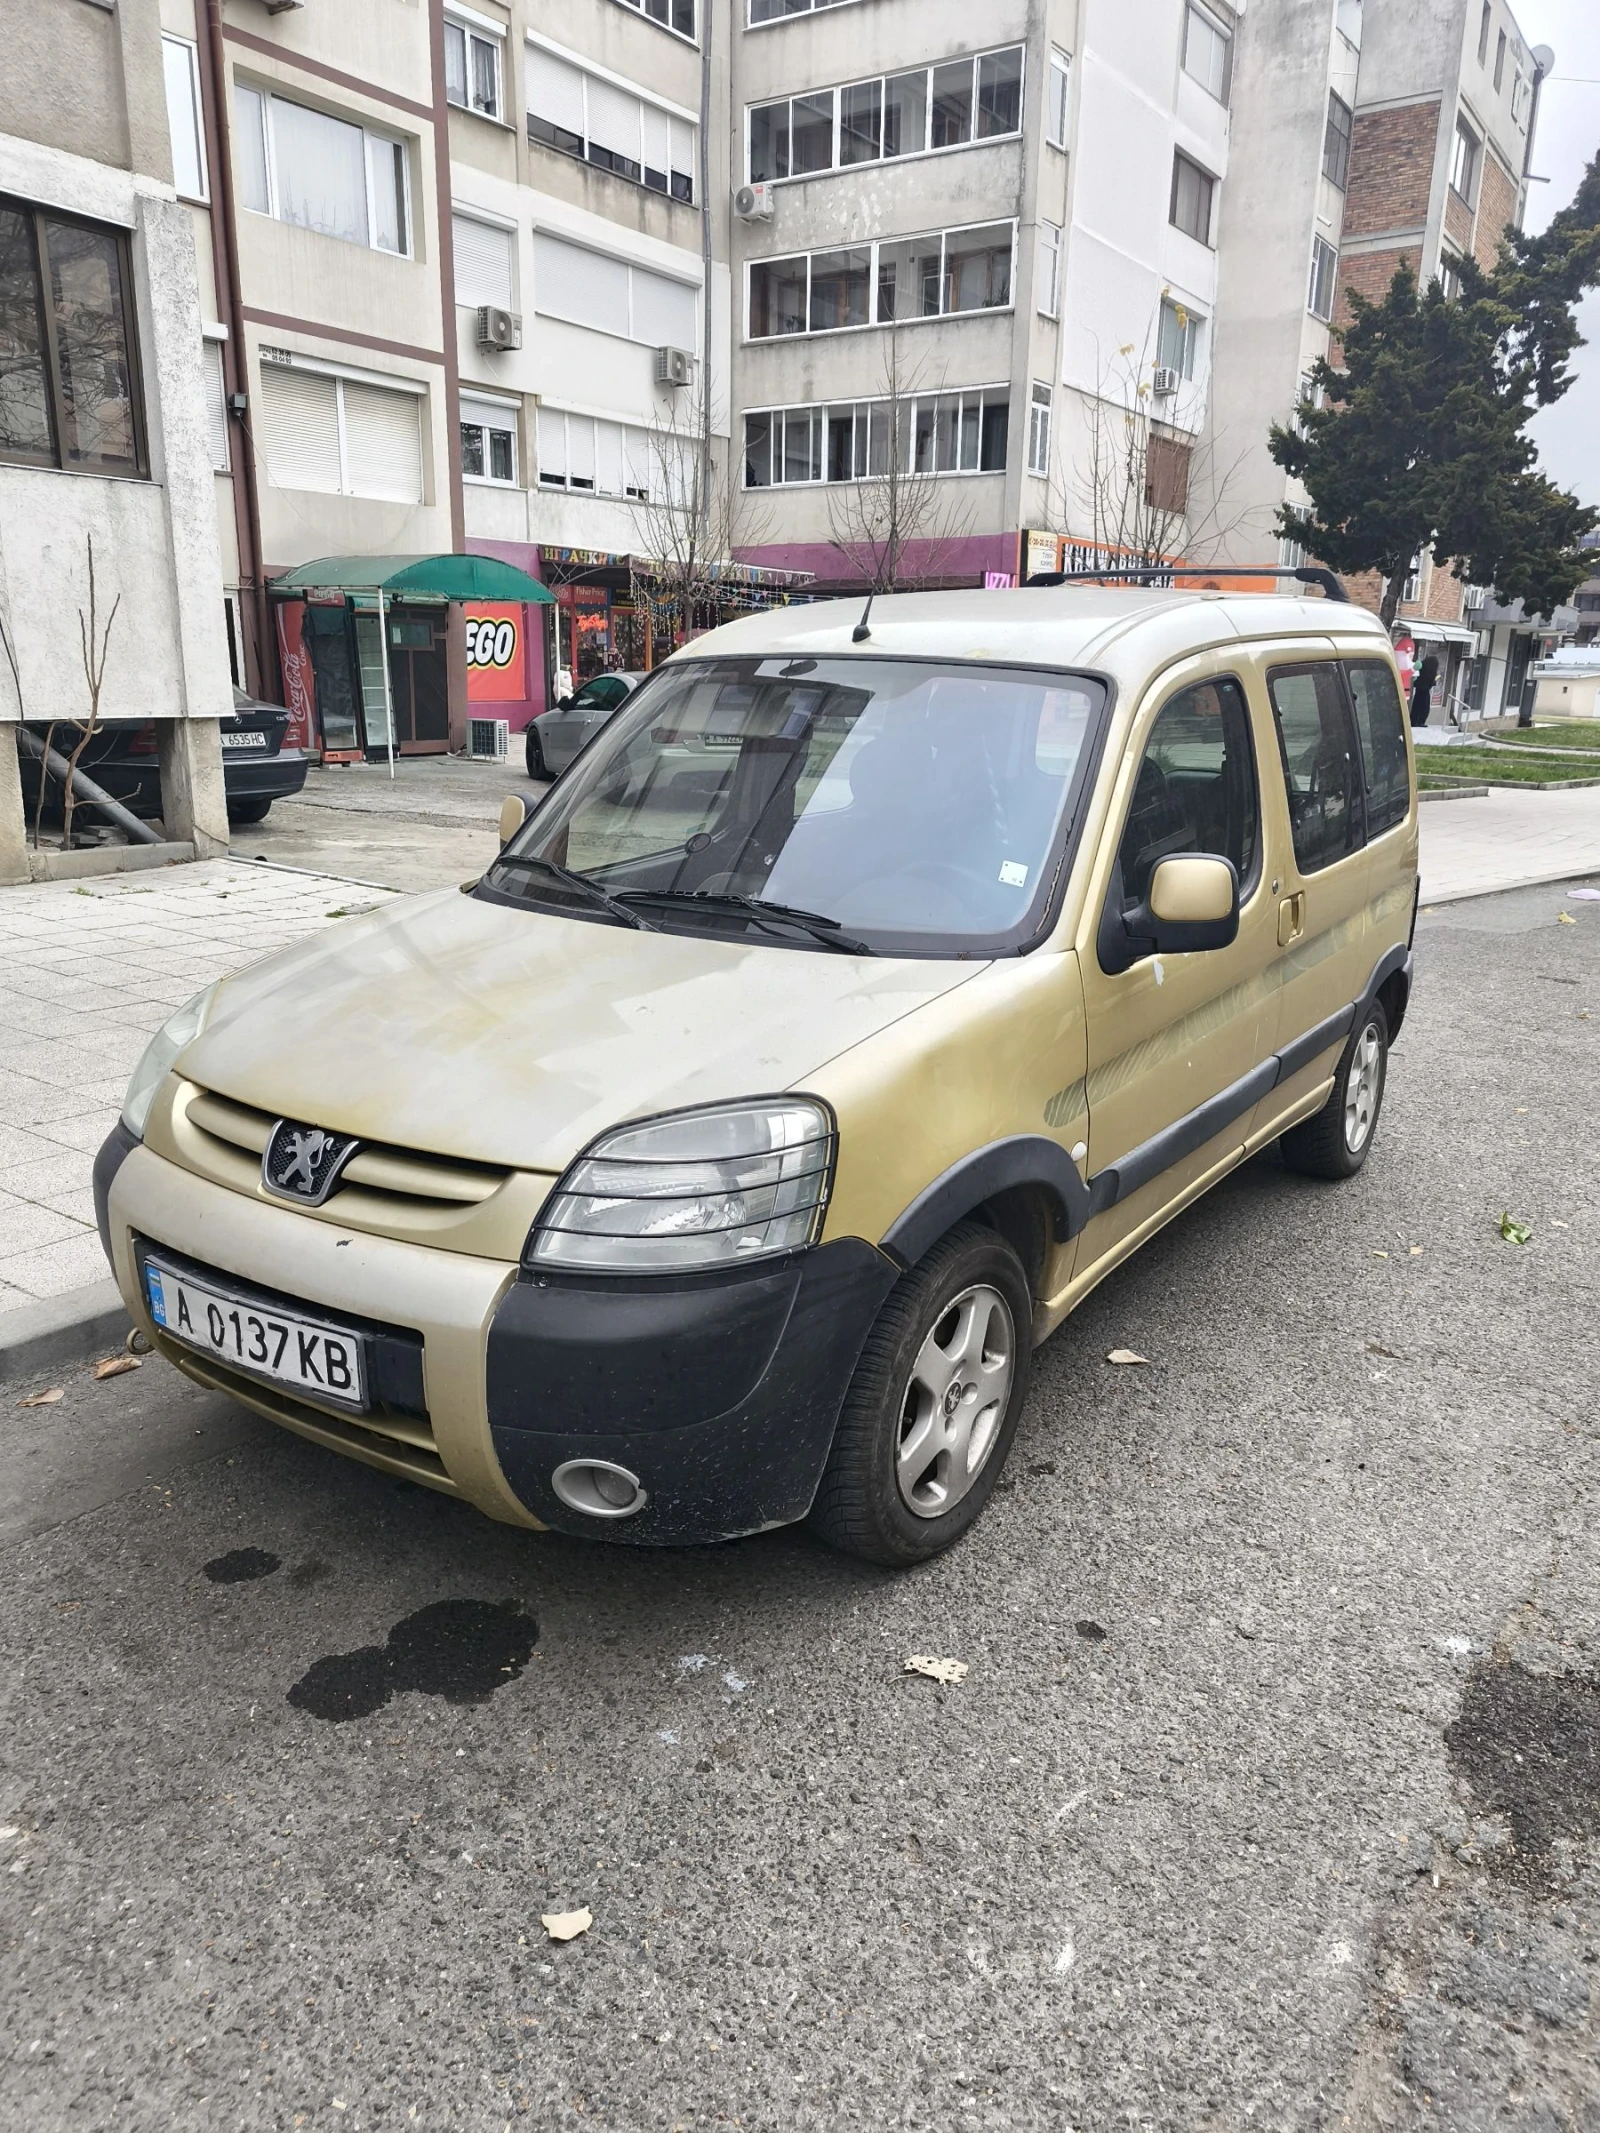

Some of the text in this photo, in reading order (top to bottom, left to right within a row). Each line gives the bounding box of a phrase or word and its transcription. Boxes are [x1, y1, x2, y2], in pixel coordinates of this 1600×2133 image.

[544, 547, 625, 566] ИГРАЧКИТЕ
[466, 619, 515, 667] EGO
[154, 1301, 165, 1317] BG
[178, 1286, 194, 1335] A
